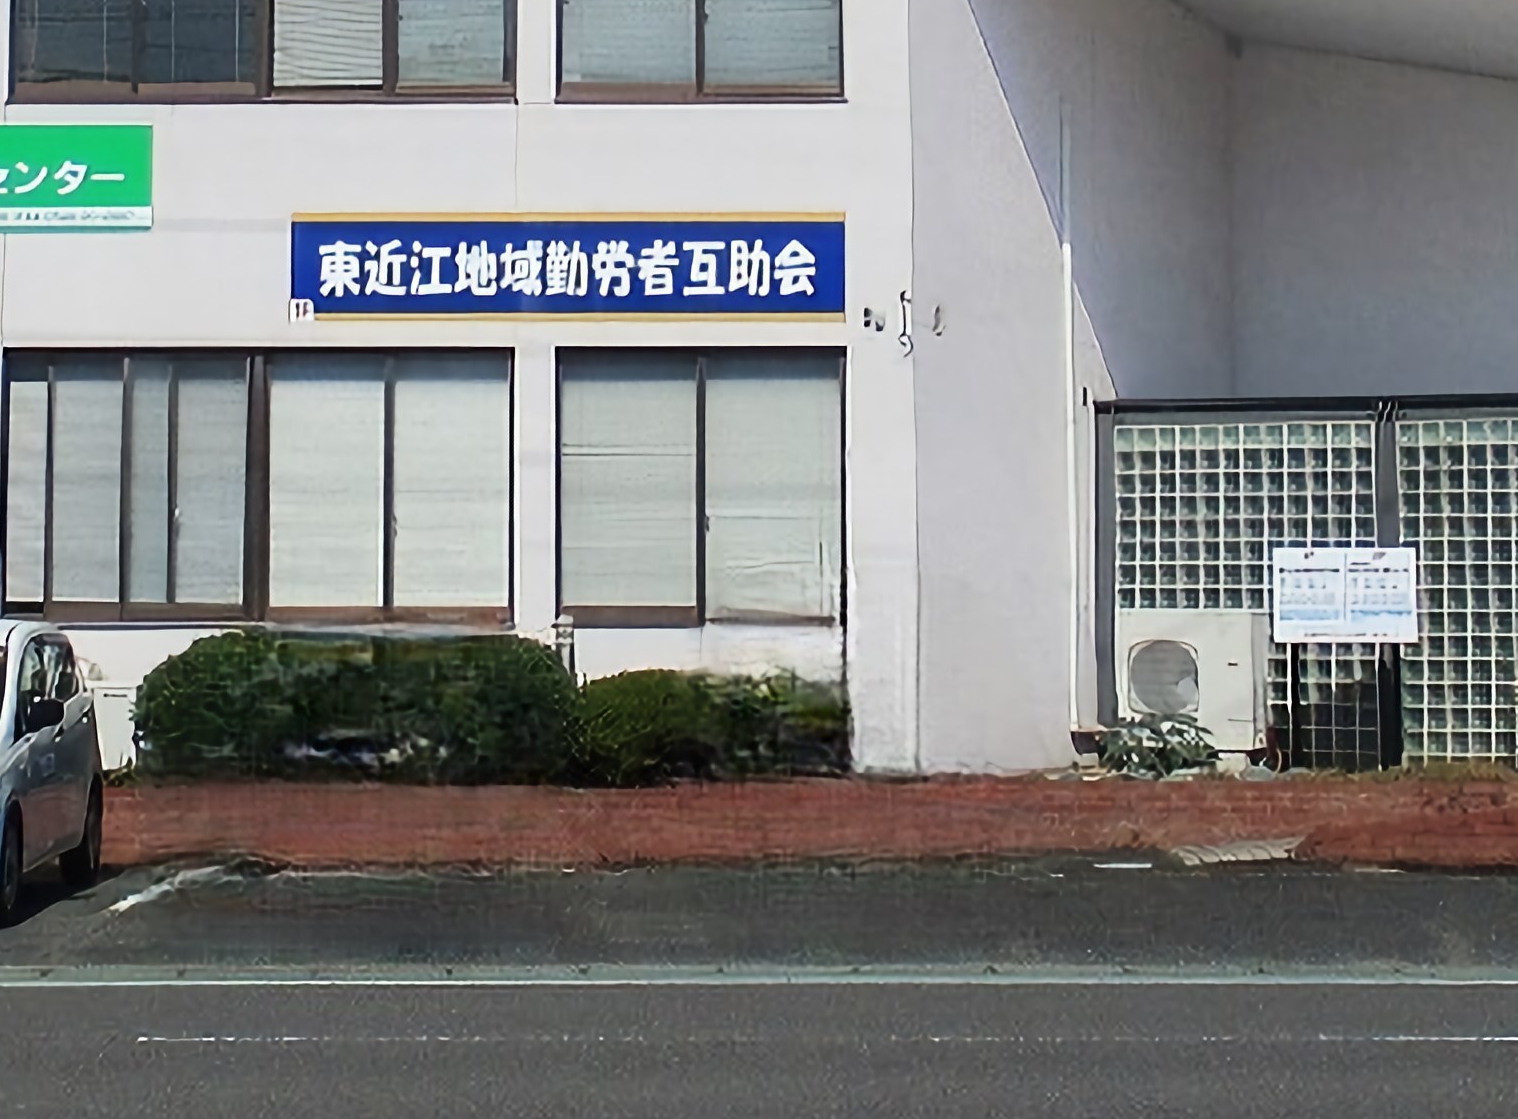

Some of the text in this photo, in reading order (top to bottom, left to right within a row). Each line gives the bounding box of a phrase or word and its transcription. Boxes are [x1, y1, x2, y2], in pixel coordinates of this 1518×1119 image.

[318, 238, 816, 298] 東近江地域勤労者互助会
